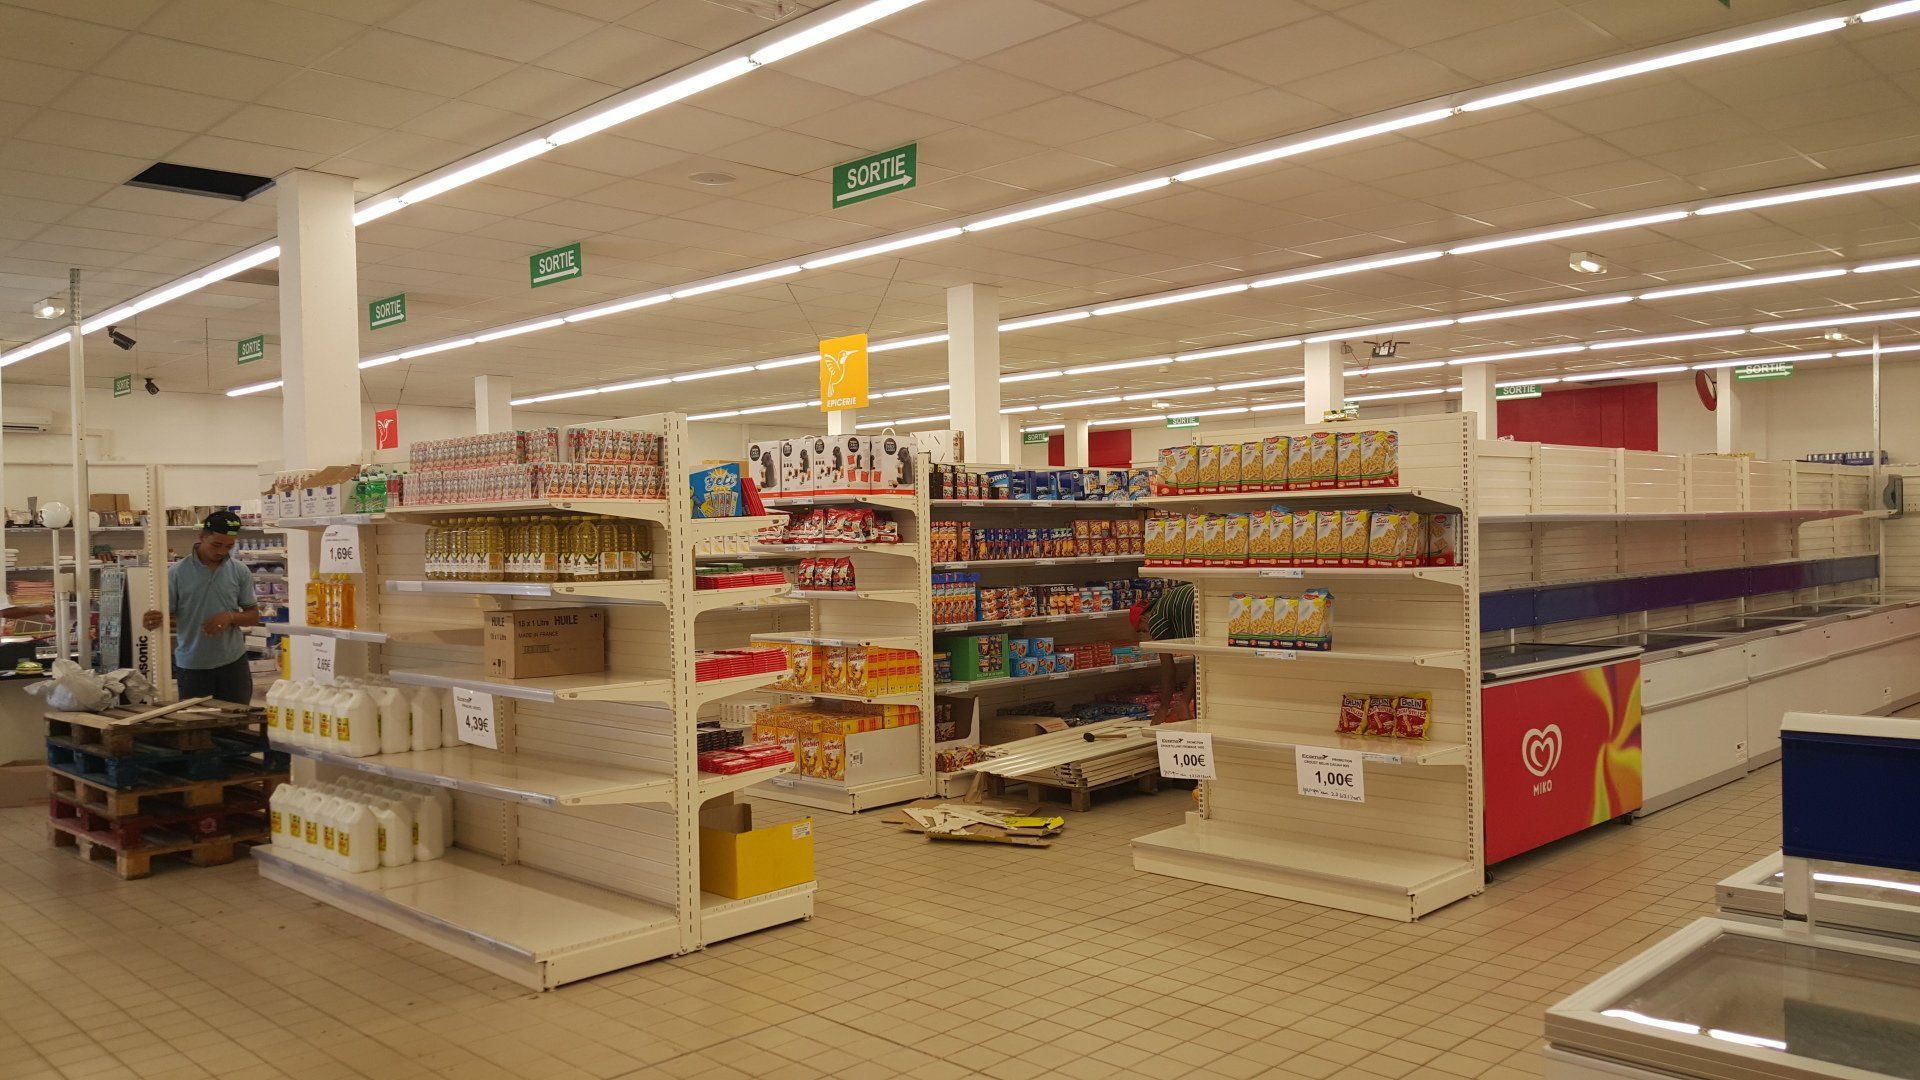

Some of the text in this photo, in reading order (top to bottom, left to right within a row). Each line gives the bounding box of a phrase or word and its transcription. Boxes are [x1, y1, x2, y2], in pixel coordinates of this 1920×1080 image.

[847, 153, 906, 189] SORTIE
[539, 249, 575, 275] SORTIE
[375, 299, 401, 319] SORTIE
[242, 339, 261, 355] SORTIE
[1745, 362, 1786, 375] SORTIE
[1503, 384, 1536, 395] SORTIE
[827, 397, 857, 408] EPICERIE
[1172, 416, 1196, 425] SORTIE
[1027, 433, 1046, 441] SORTIE
[330, 547, 353, 562] 1,69€
[491, 617, 505, 627] HUILE
[554, 615, 578, 626] HUILE
[466, 715, 489, 733] 4,39€
[1173, 753, 1206, 768] 1,00€
[1315, 771, 1354, 787] 1,00€
[1533, 780, 1552, 796] MIKO
